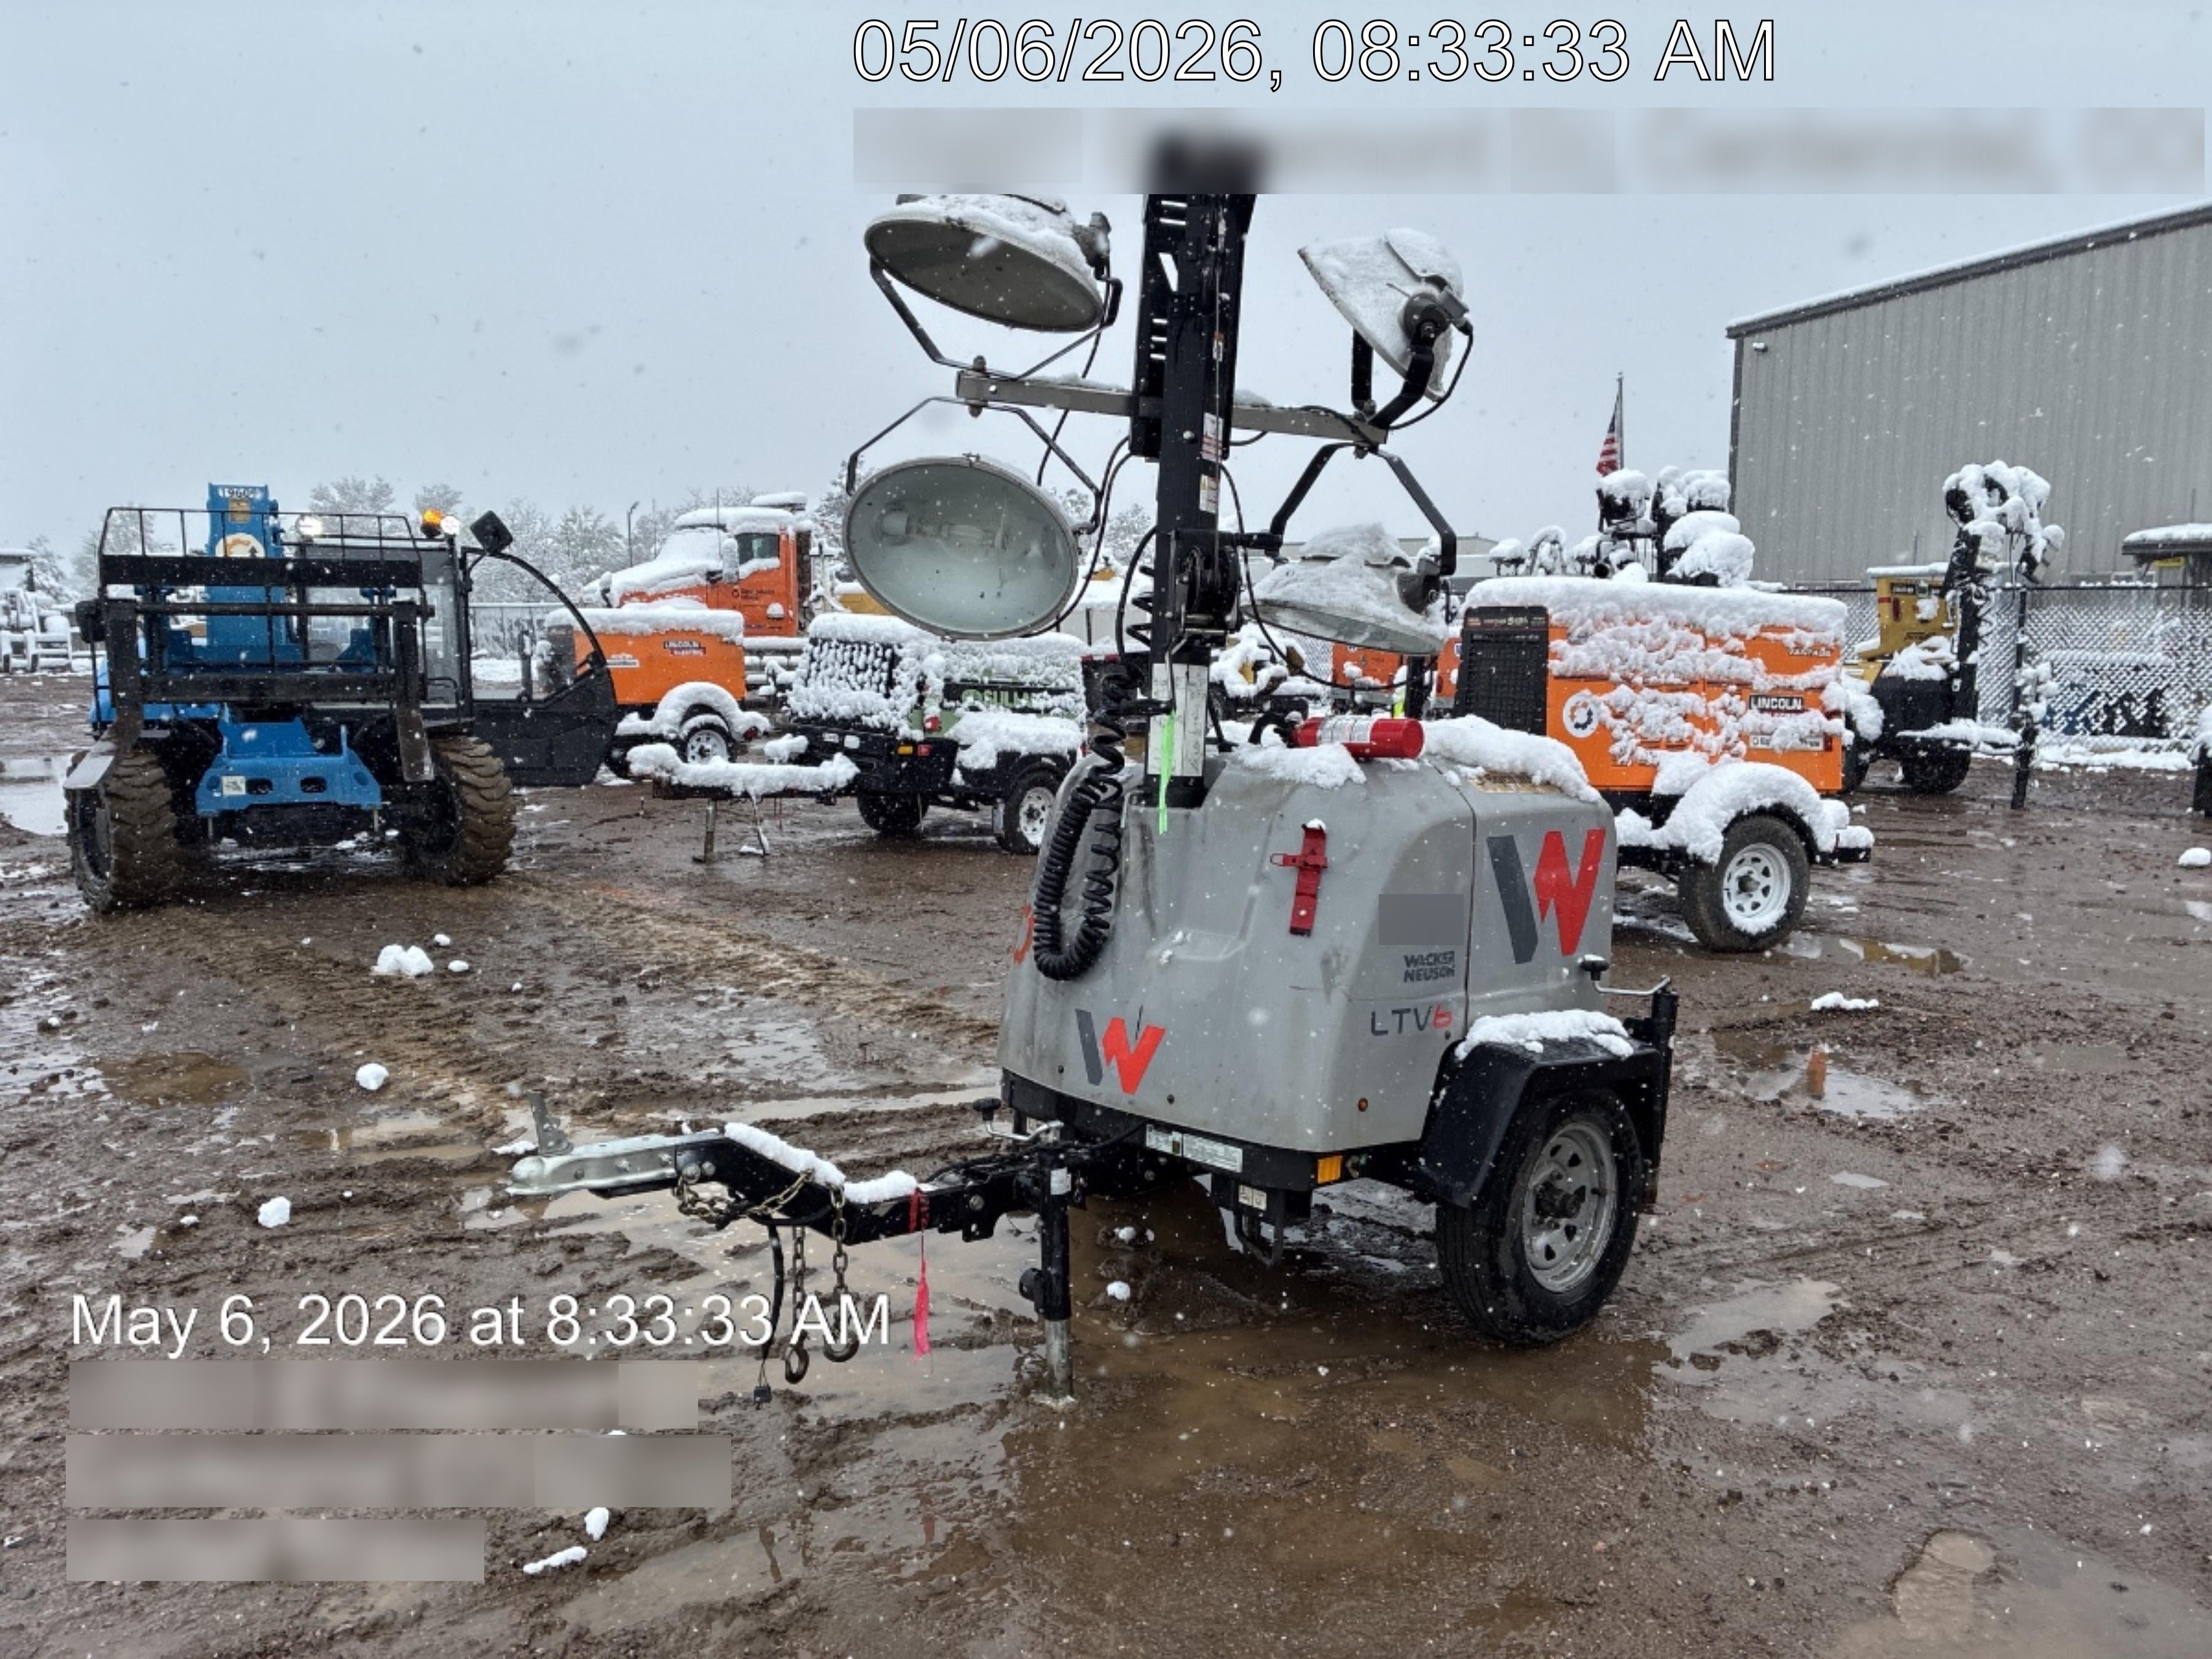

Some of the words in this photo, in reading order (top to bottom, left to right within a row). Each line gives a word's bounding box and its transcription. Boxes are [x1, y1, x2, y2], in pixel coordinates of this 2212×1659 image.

[1751, 696, 1803, 710] LINCOLN
[1403, 951, 1456, 968] WACKER
[1403, 965, 1456, 983] NEUSON
[1370, 1003, 1454, 1037] LTV6
